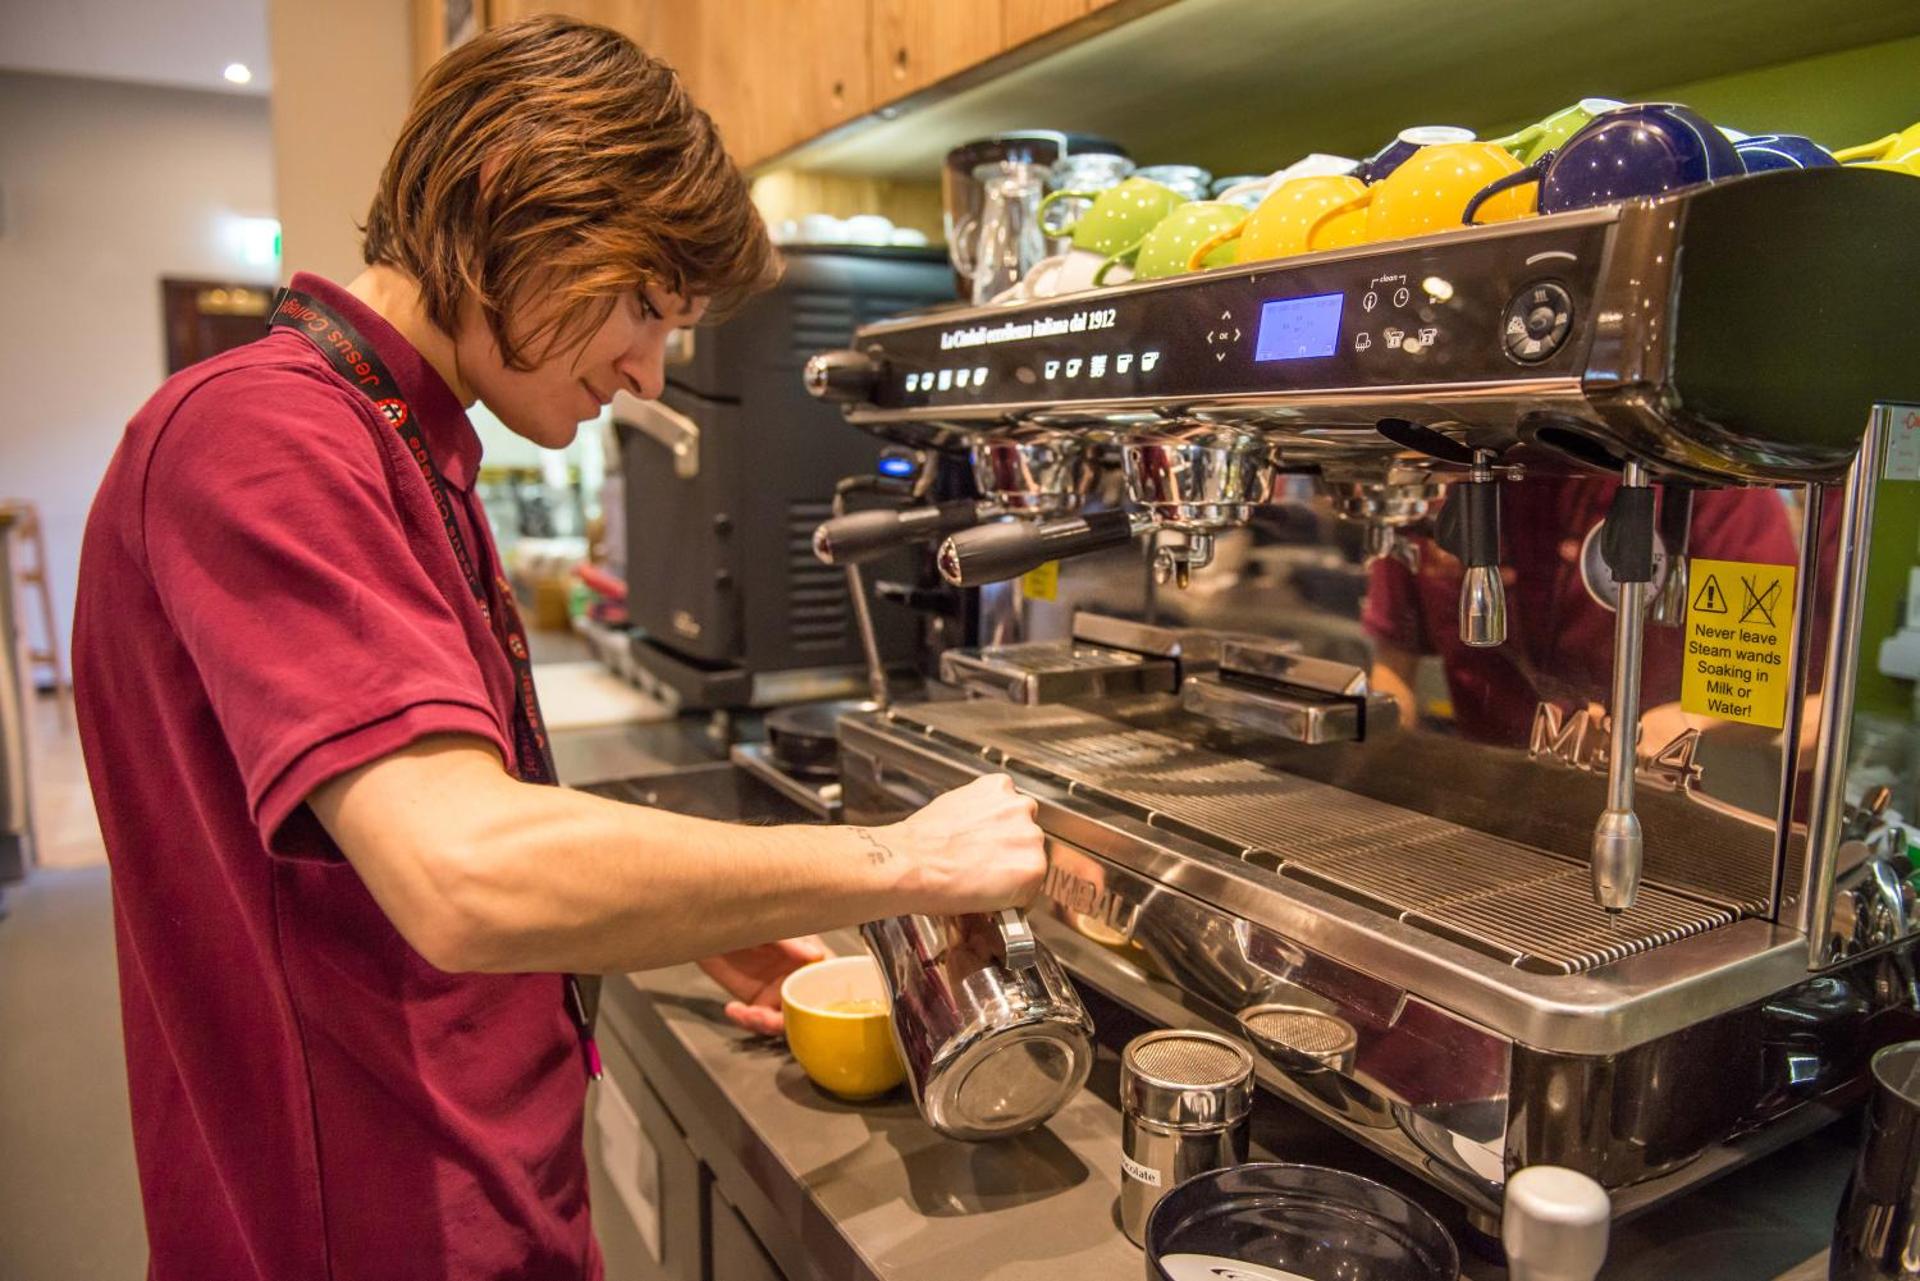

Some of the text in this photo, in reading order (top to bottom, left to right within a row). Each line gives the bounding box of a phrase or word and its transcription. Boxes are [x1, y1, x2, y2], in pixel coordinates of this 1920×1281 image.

[1379, 274, 1399, 282] clean
[1088, 308, 1117, 330] 1912
[327, 330, 380, 385] Jesus
[1695, 623, 1777, 646] Never leave
[1689, 640, 1782, 665] Steam wands
[1697, 660, 1769, 683] Soaking in
[1706, 679, 1752, 699] Milk or
[1708, 699, 1752, 718] Water!
[1528, 701, 1704, 792] M4
[1040, 865, 1141, 938] IMBALI
